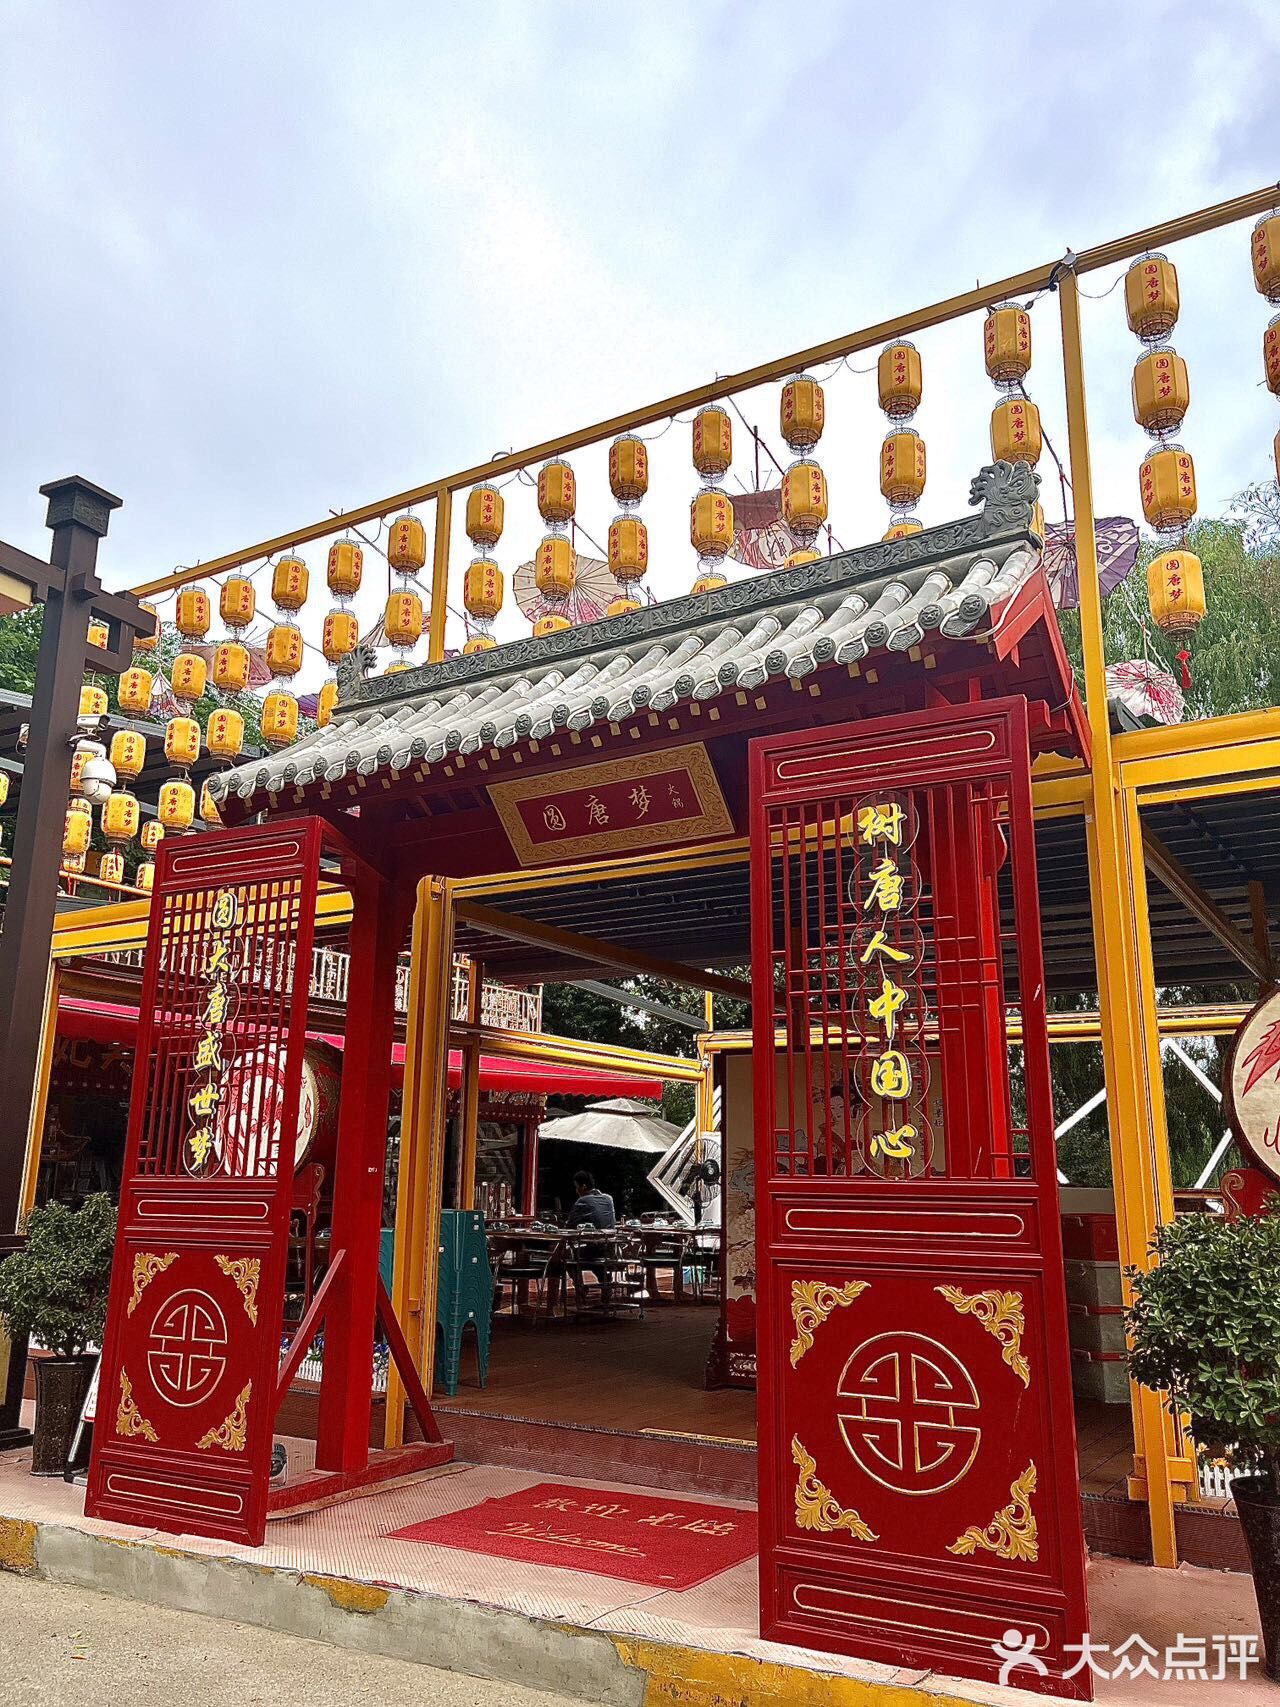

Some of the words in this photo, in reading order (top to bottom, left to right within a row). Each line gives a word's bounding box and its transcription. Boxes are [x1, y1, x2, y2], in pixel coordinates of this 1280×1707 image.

[1144, 263, 1162, 303] 圆唐梦
[893, 350, 908, 386] 圆唐梦
[1155, 358, 1173, 399] 圆唐梦
[1010, 404, 1026, 444] 圆唐梦
[1165, 559, 1184, 604] 圆唐梦
[857, 801, 916, 1160] 树唐人中国心
